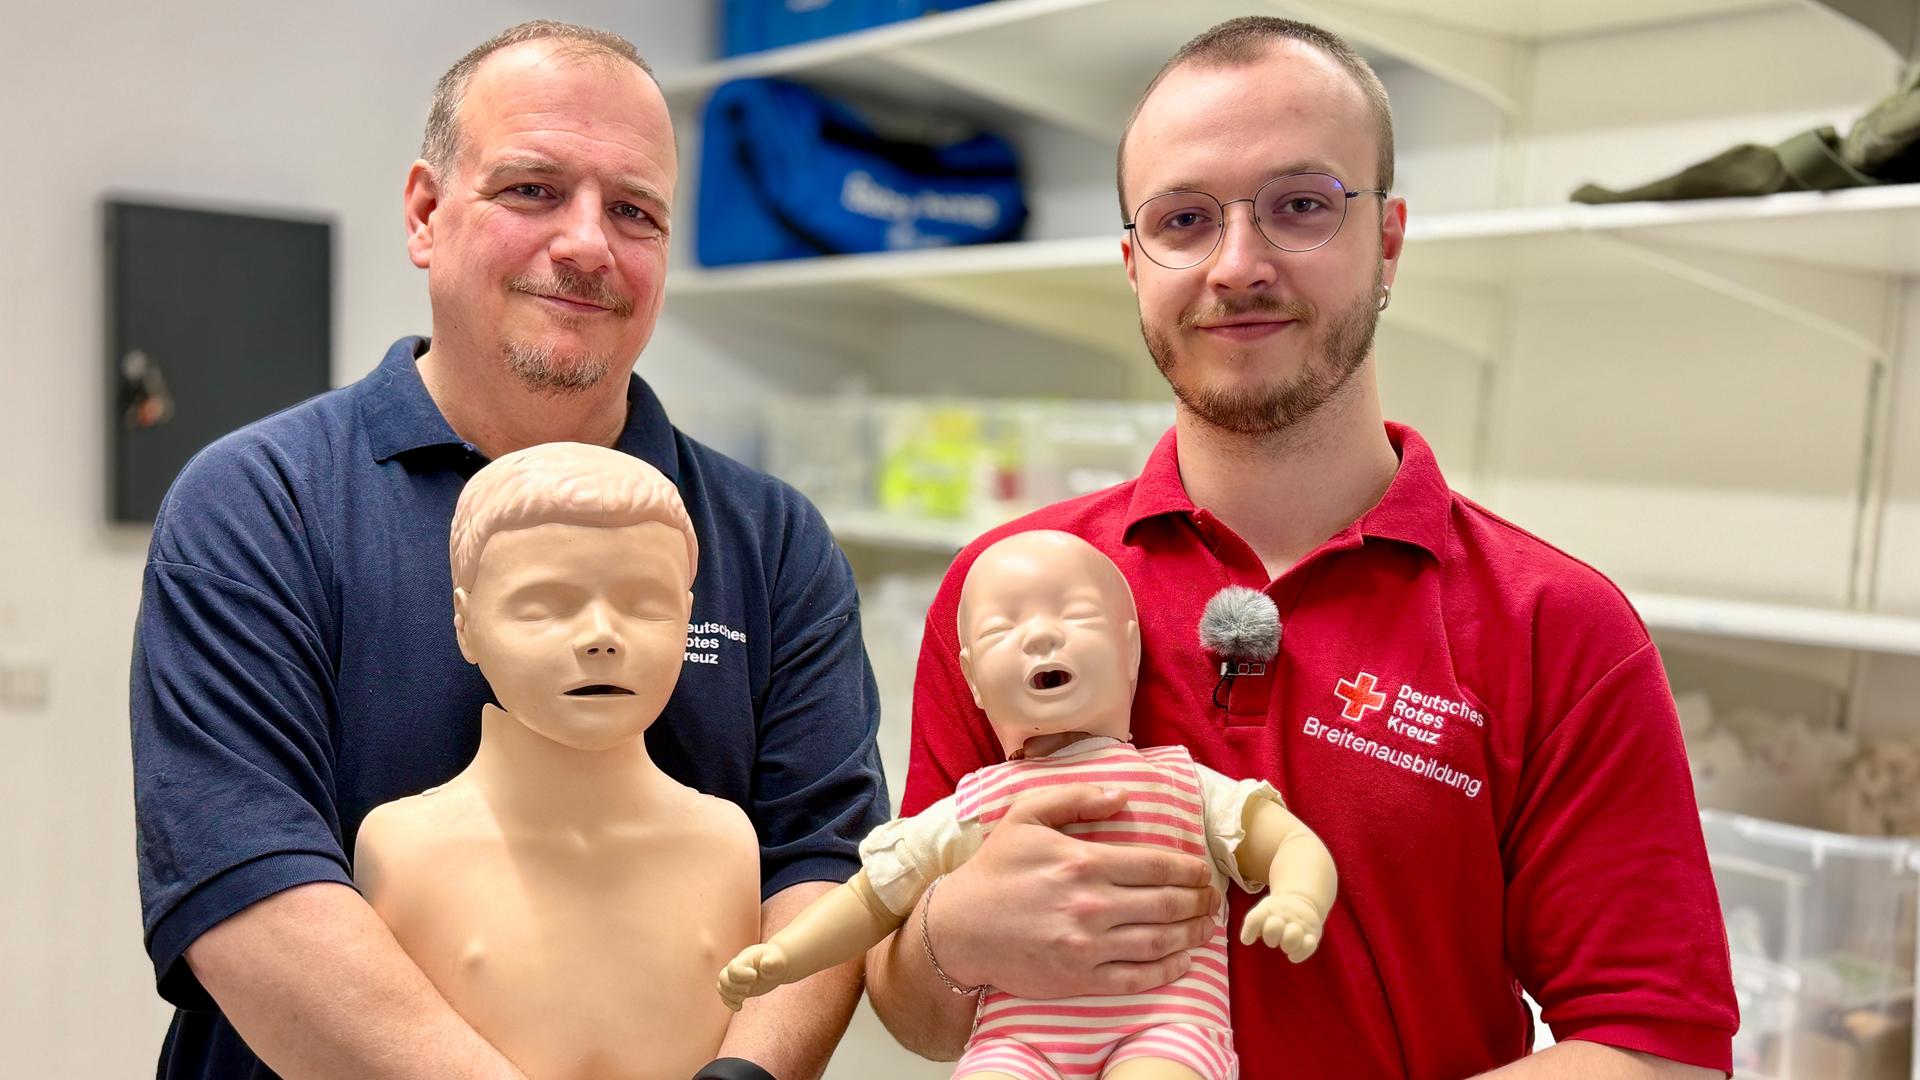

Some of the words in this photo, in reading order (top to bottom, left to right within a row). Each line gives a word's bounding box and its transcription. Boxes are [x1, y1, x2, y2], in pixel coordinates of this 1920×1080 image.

[686, 636, 720, 649] otes
[687, 621, 747, 643] eutsches
[683, 651, 719, 665] reuz
[1393, 699, 1444, 729] Rotes
[1398, 684, 1484, 727] Deutsches
[1387, 715, 1441, 745] Kreuz
[1303, 716, 1482, 797] Breitenausbildung
